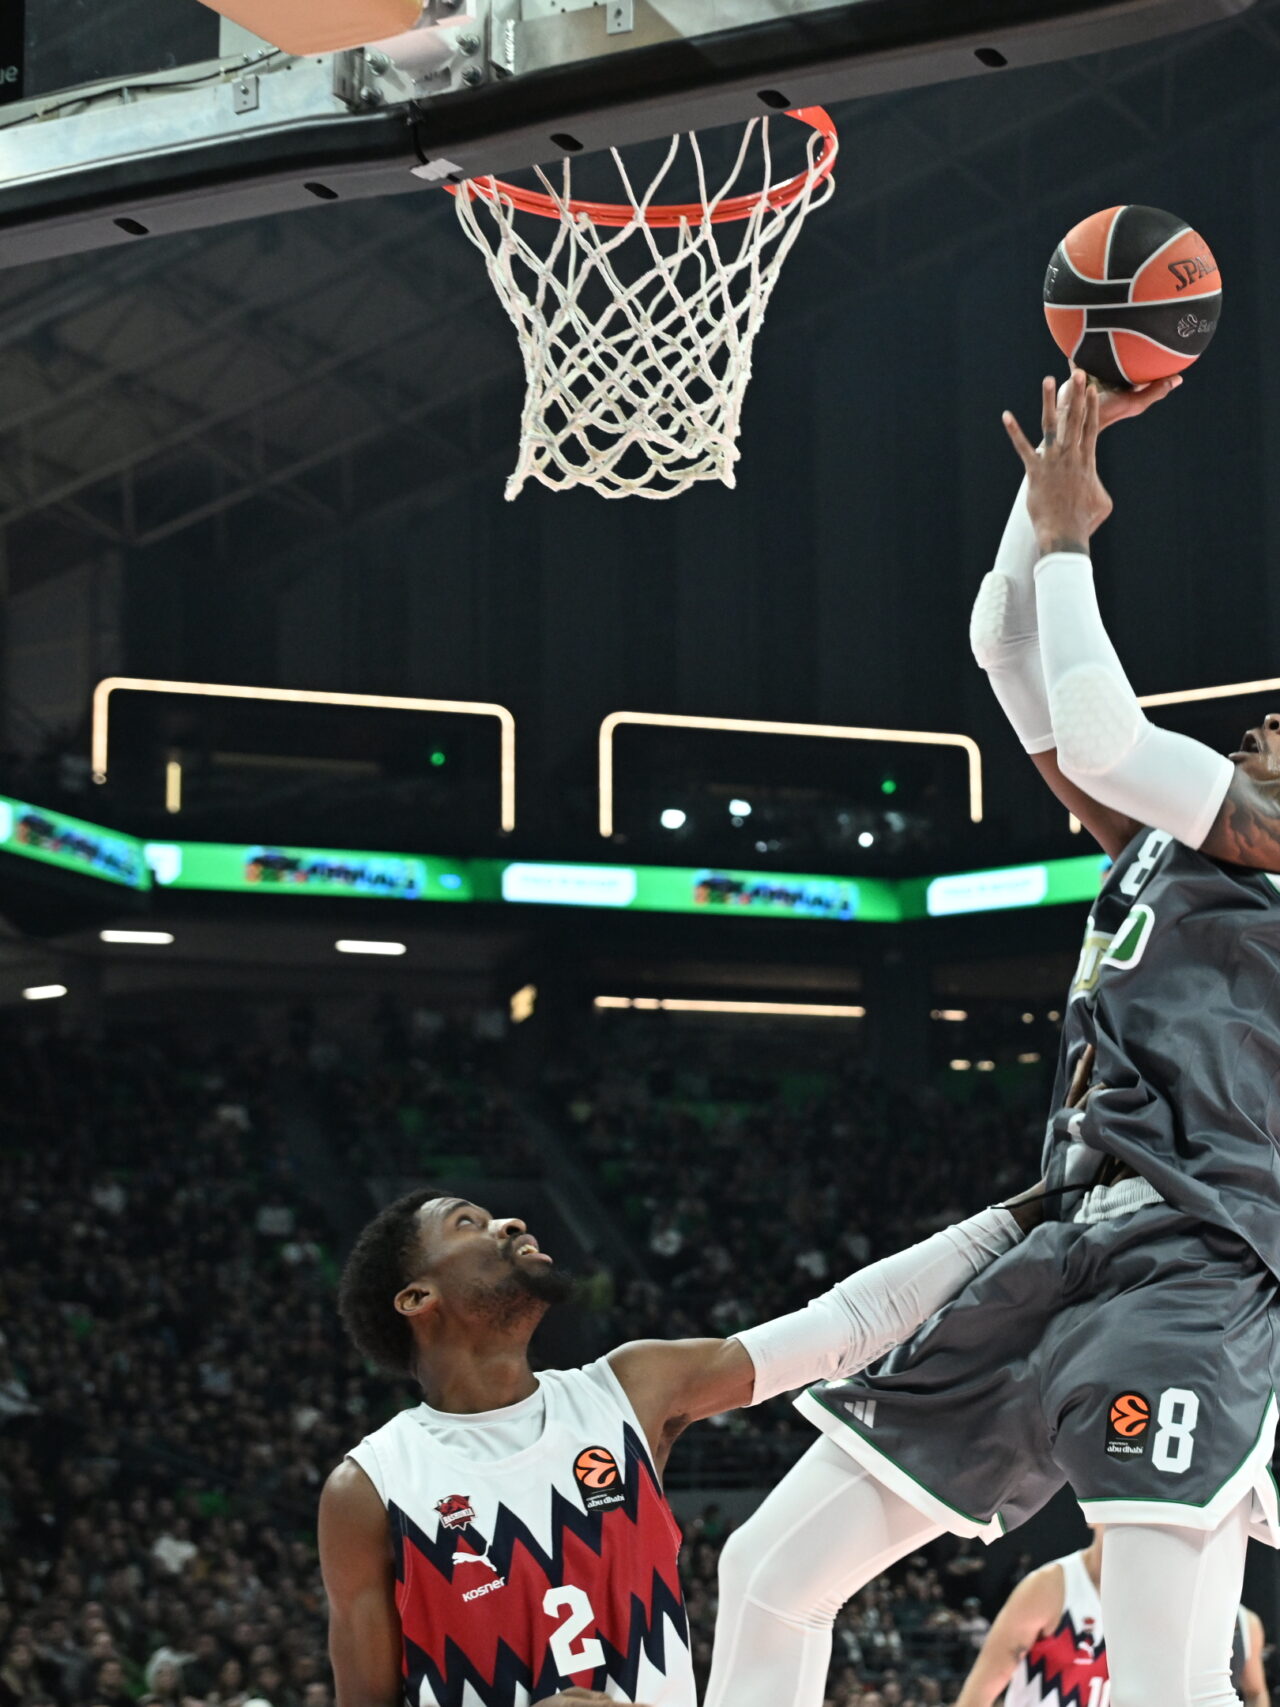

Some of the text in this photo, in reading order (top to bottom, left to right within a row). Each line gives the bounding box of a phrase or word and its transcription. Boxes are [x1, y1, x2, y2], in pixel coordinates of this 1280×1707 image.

[1119, 829, 1174, 897] 8
[1151, 1387, 1200, 1474] 8
[542, 1584, 606, 1677] 2
